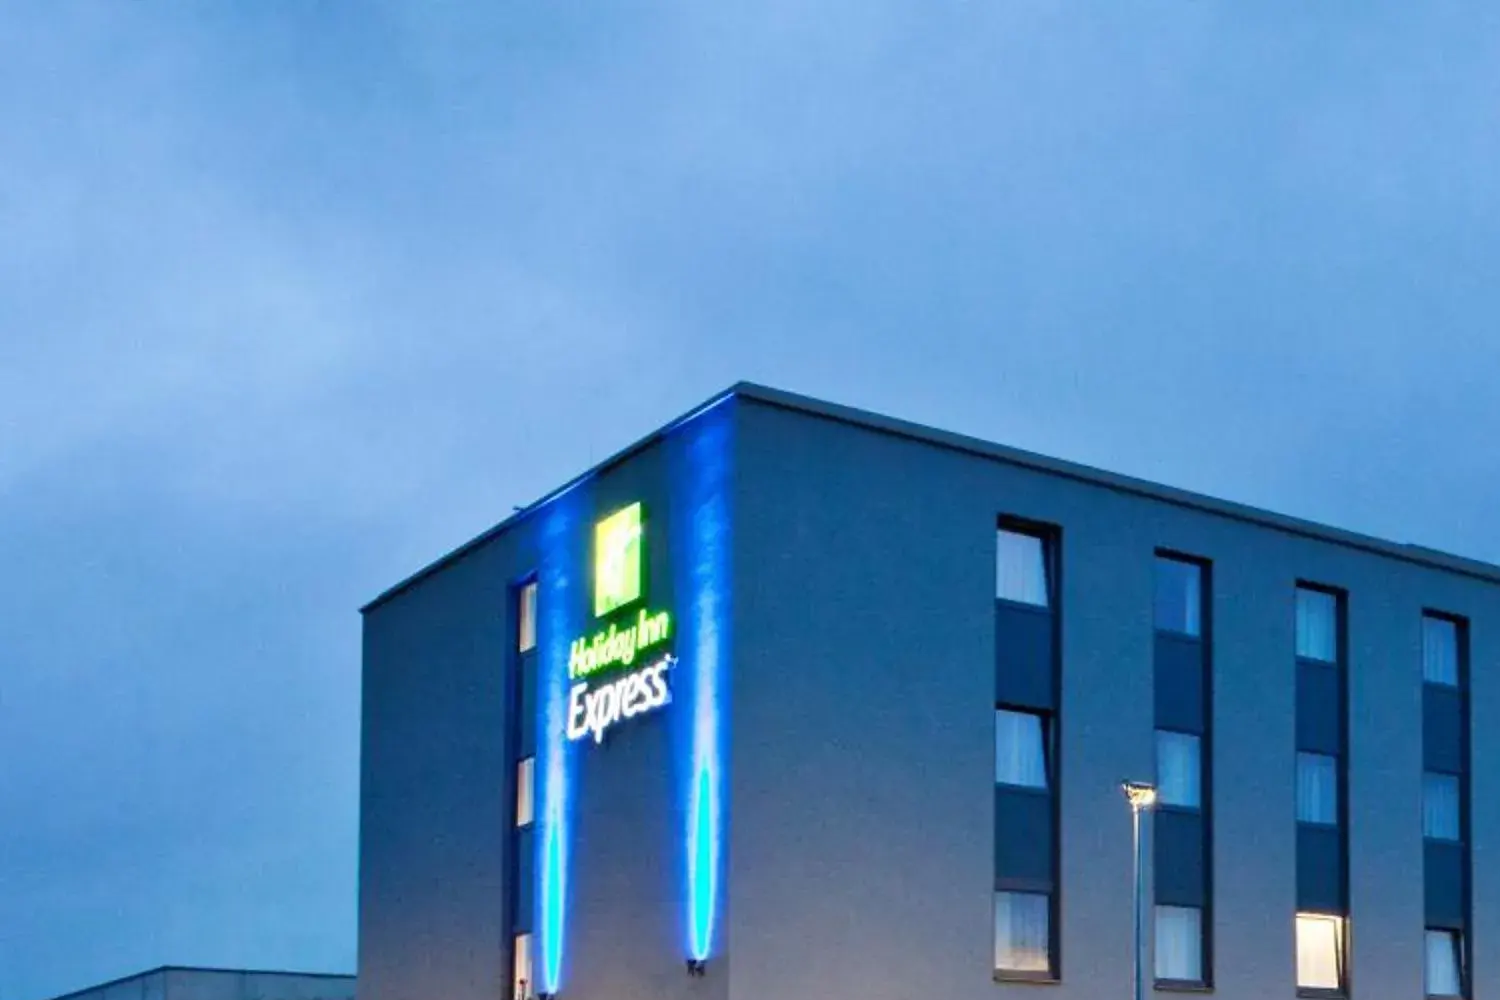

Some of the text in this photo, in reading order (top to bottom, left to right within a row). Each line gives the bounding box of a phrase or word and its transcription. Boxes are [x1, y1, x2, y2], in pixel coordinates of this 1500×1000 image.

[568, 608, 669, 680] Holiday Inn
[567, 660, 672, 744] Express
